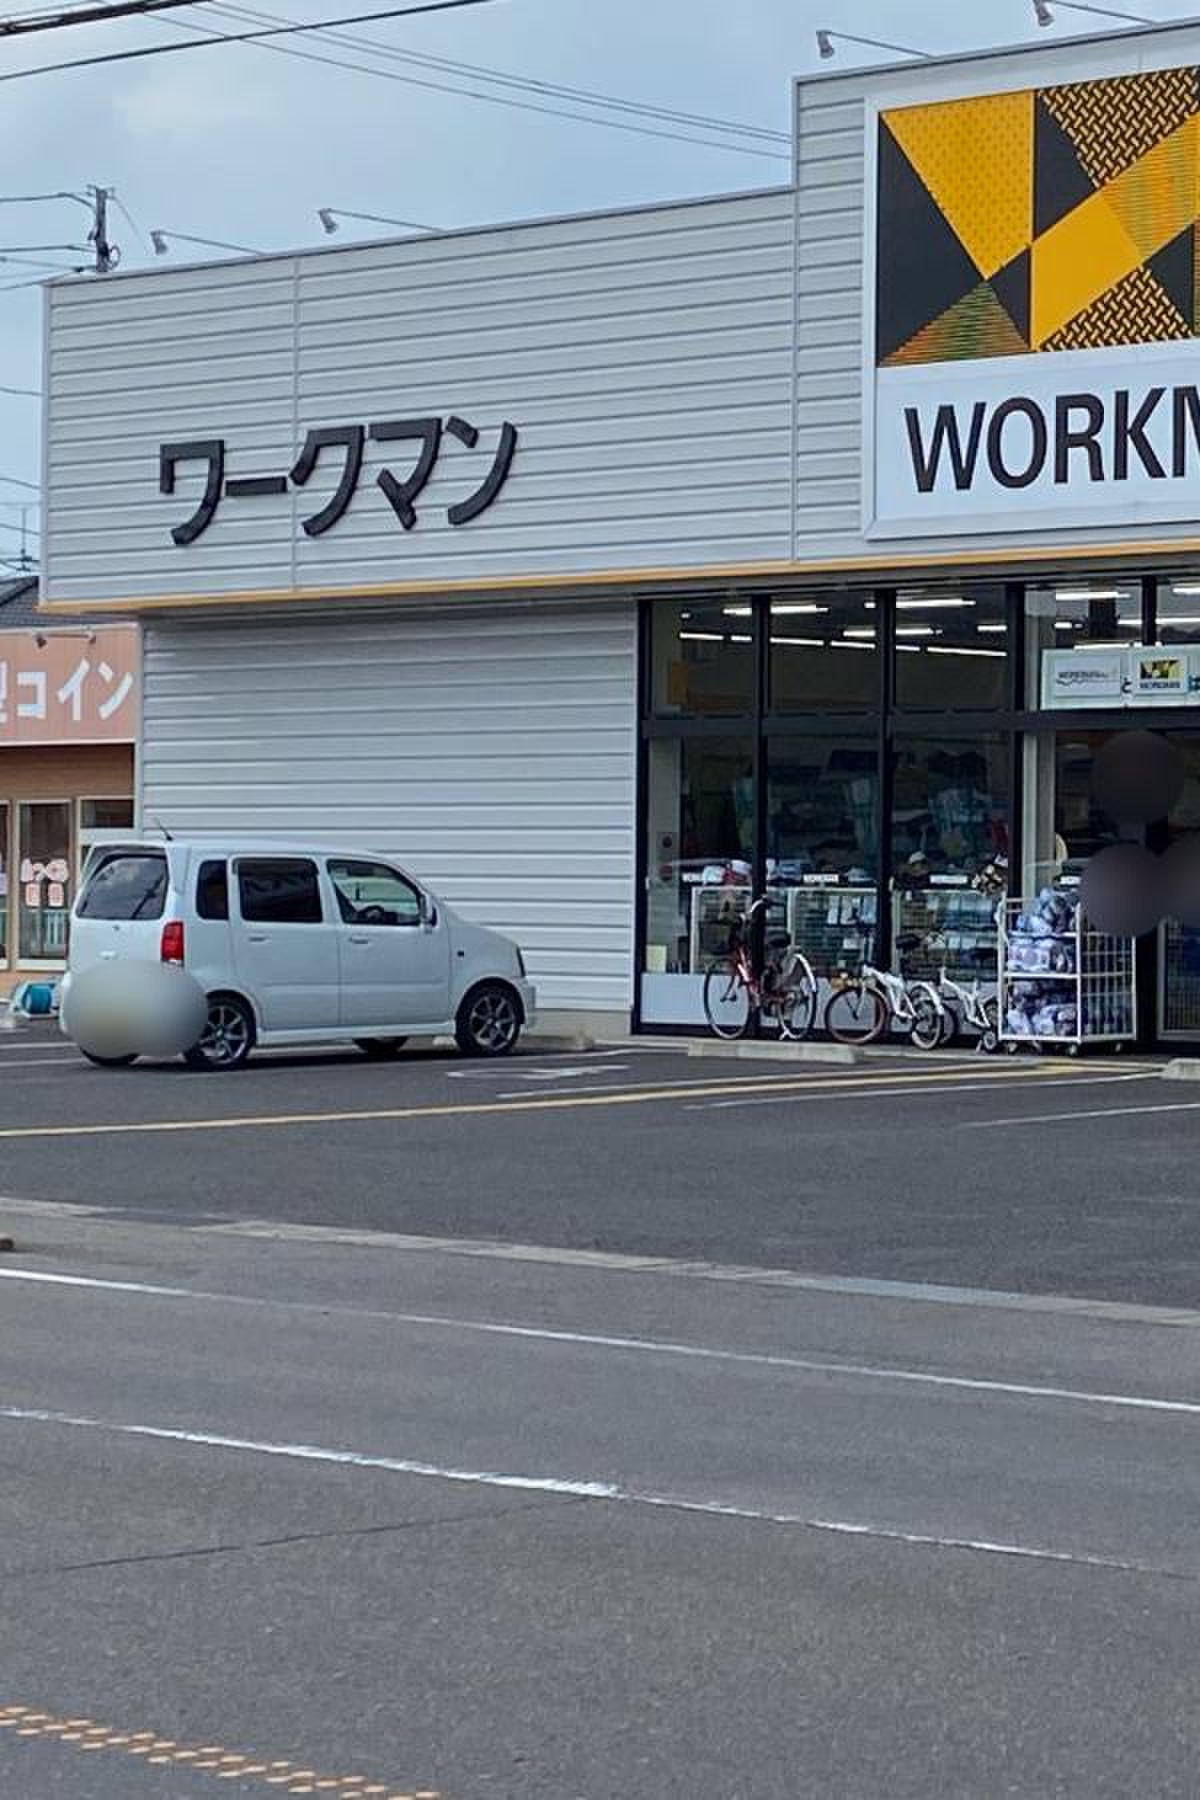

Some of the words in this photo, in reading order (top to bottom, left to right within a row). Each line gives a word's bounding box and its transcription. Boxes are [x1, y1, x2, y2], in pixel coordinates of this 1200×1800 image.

[160, 416, 517, 545] ワークマン
[0, 657, 133, 722] コイン
[1121, 677, 1132, 694] と
